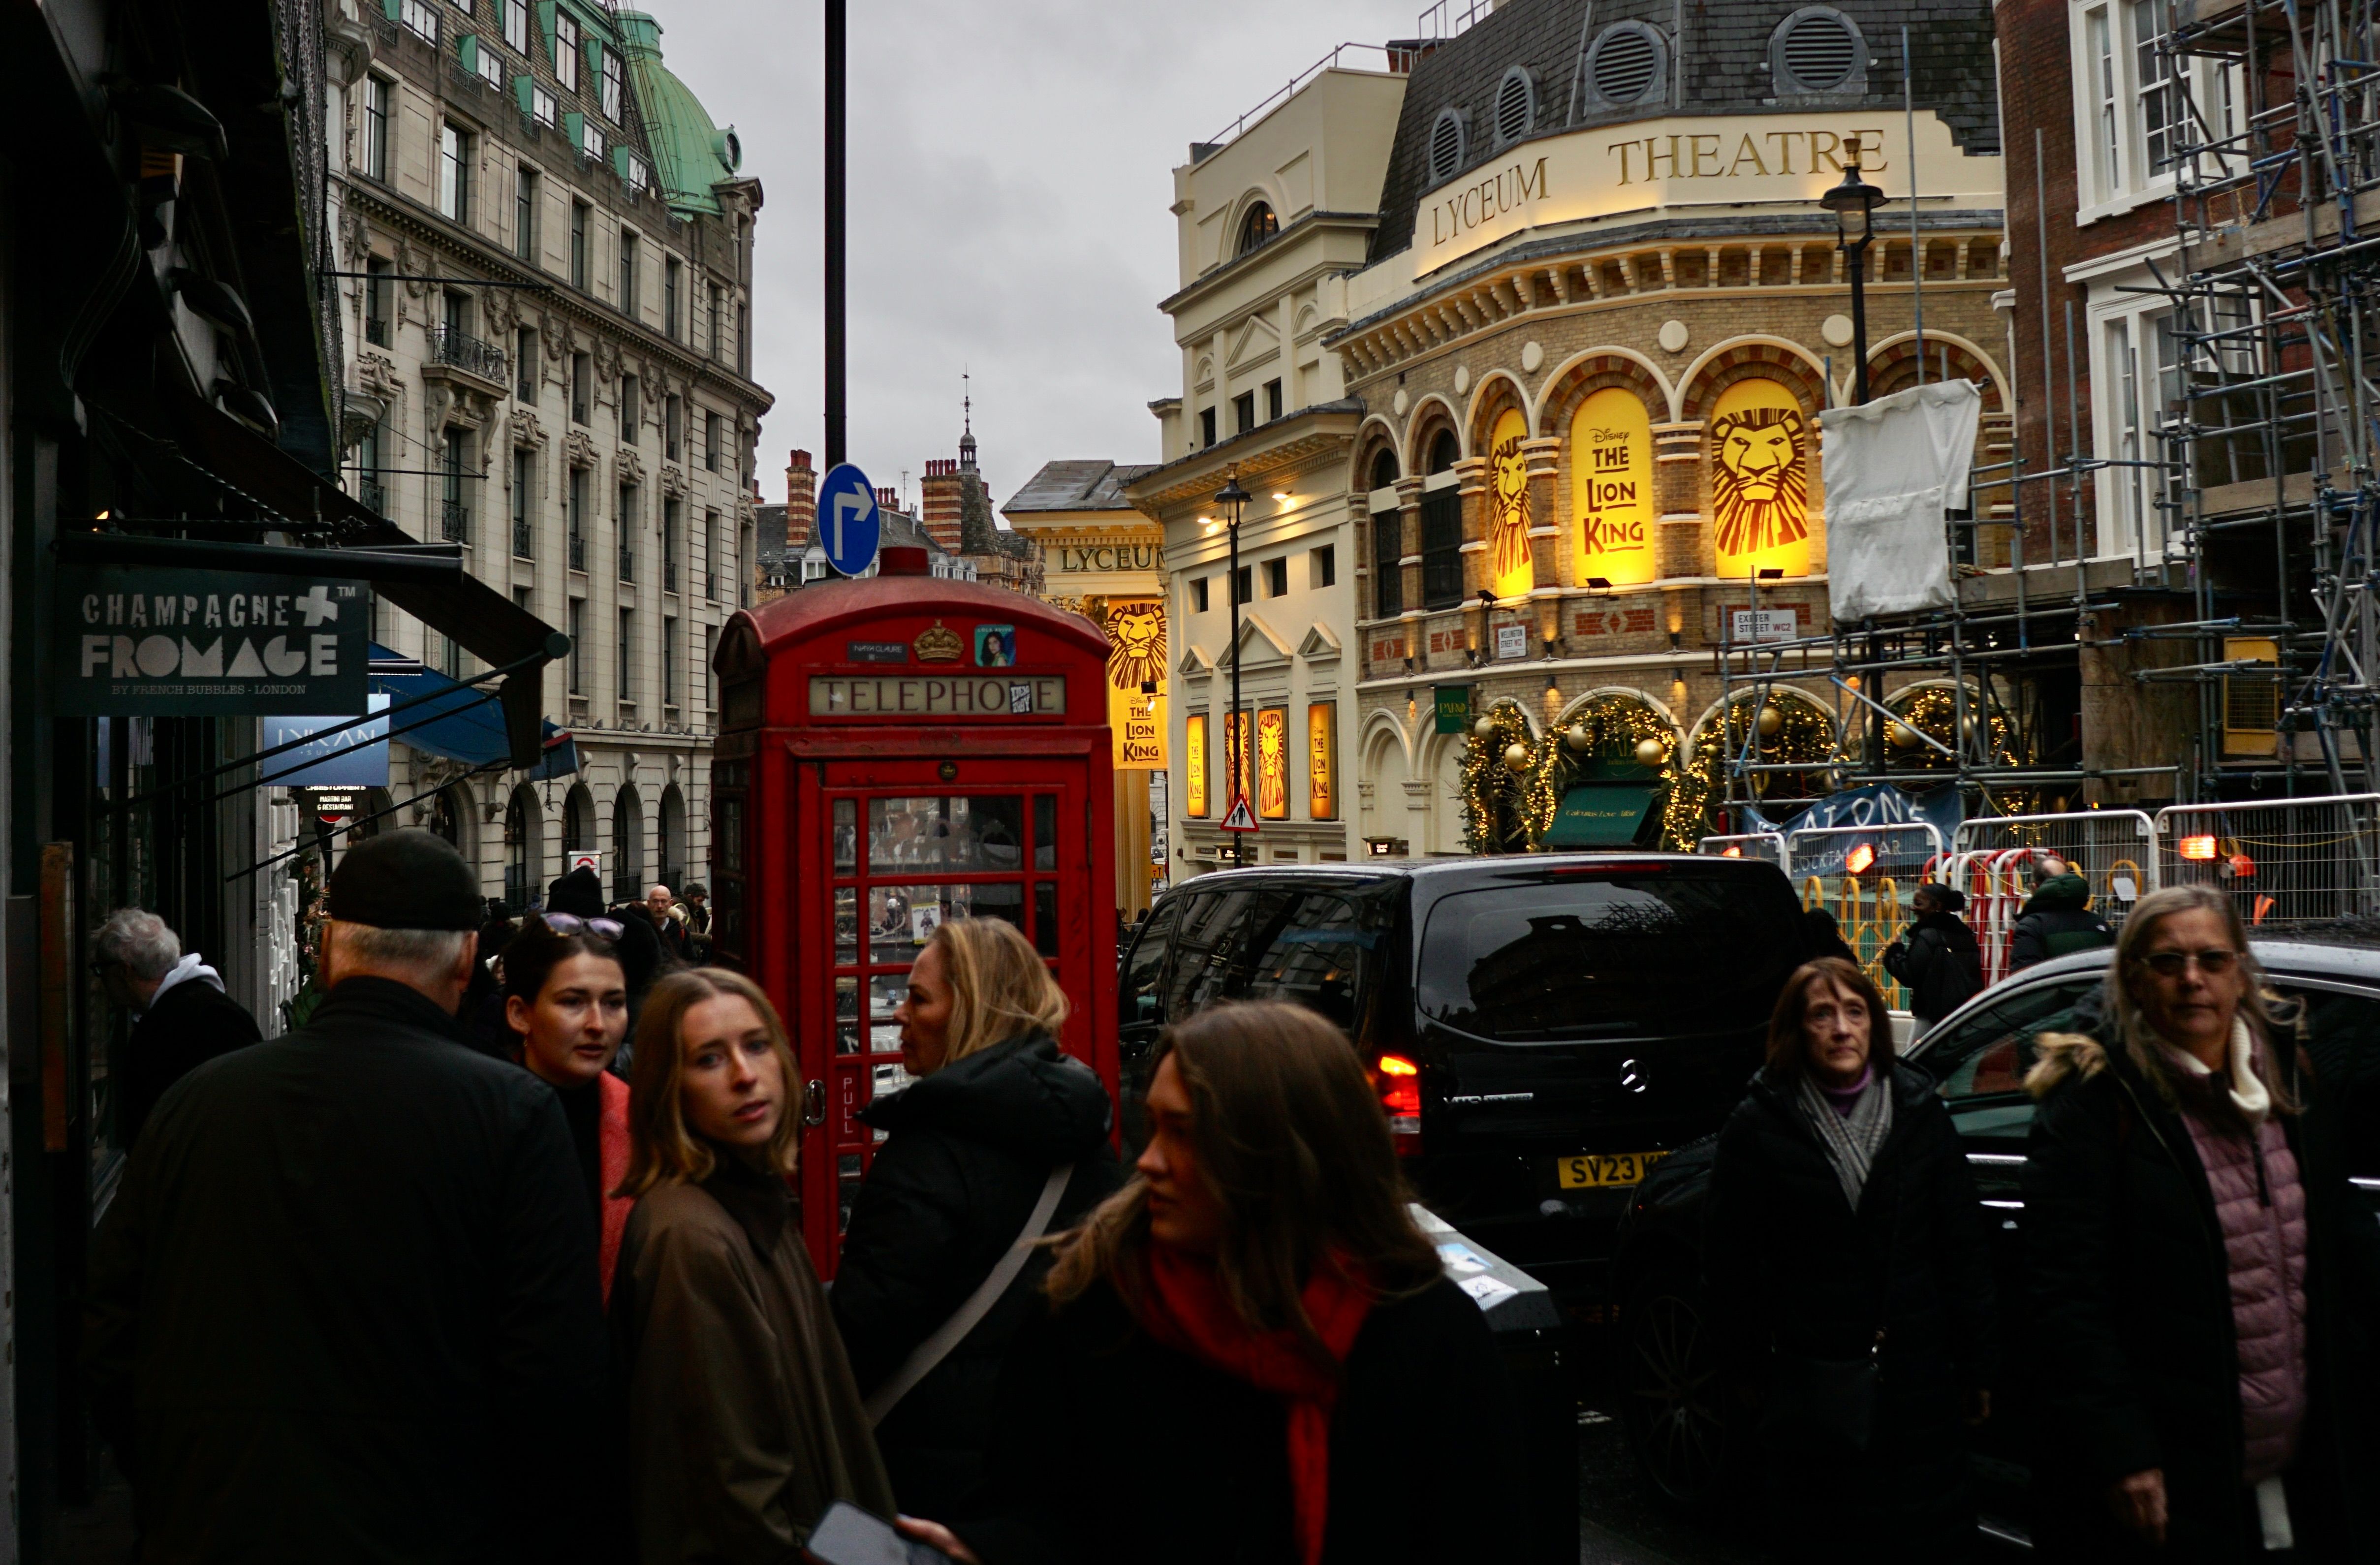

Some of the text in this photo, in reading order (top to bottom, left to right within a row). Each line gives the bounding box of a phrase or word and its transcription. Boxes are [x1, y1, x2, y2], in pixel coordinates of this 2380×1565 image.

[1432, 129, 1888, 247] LYCEUM THEATRE
[1589, 429, 1629, 443] Disney
[1592, 446, 1629, 468] THE
[83, 593, 290, 628] CHAMPAGNE
[1501, 629, 1522, 638] WELLINGTON
[1501, 640, 1512, 648] STREET
[82, 635, 338, 678] FROMAGE
[112, 685, 130, 694] BY
[132, 685, 185, 694] FRENCH
[186, 685, 245, 694] BUBBLES
[254, 685, 307, 694] LONDON
[820, 681, 1055, 712] TELEPHOE
[1129, 707, 1151, 717] THE
[1315, 738, 1323, 749] THE
[844, 1077, 853, 1134] PULL
[1570, 1157, 1636, 1183] SV23
